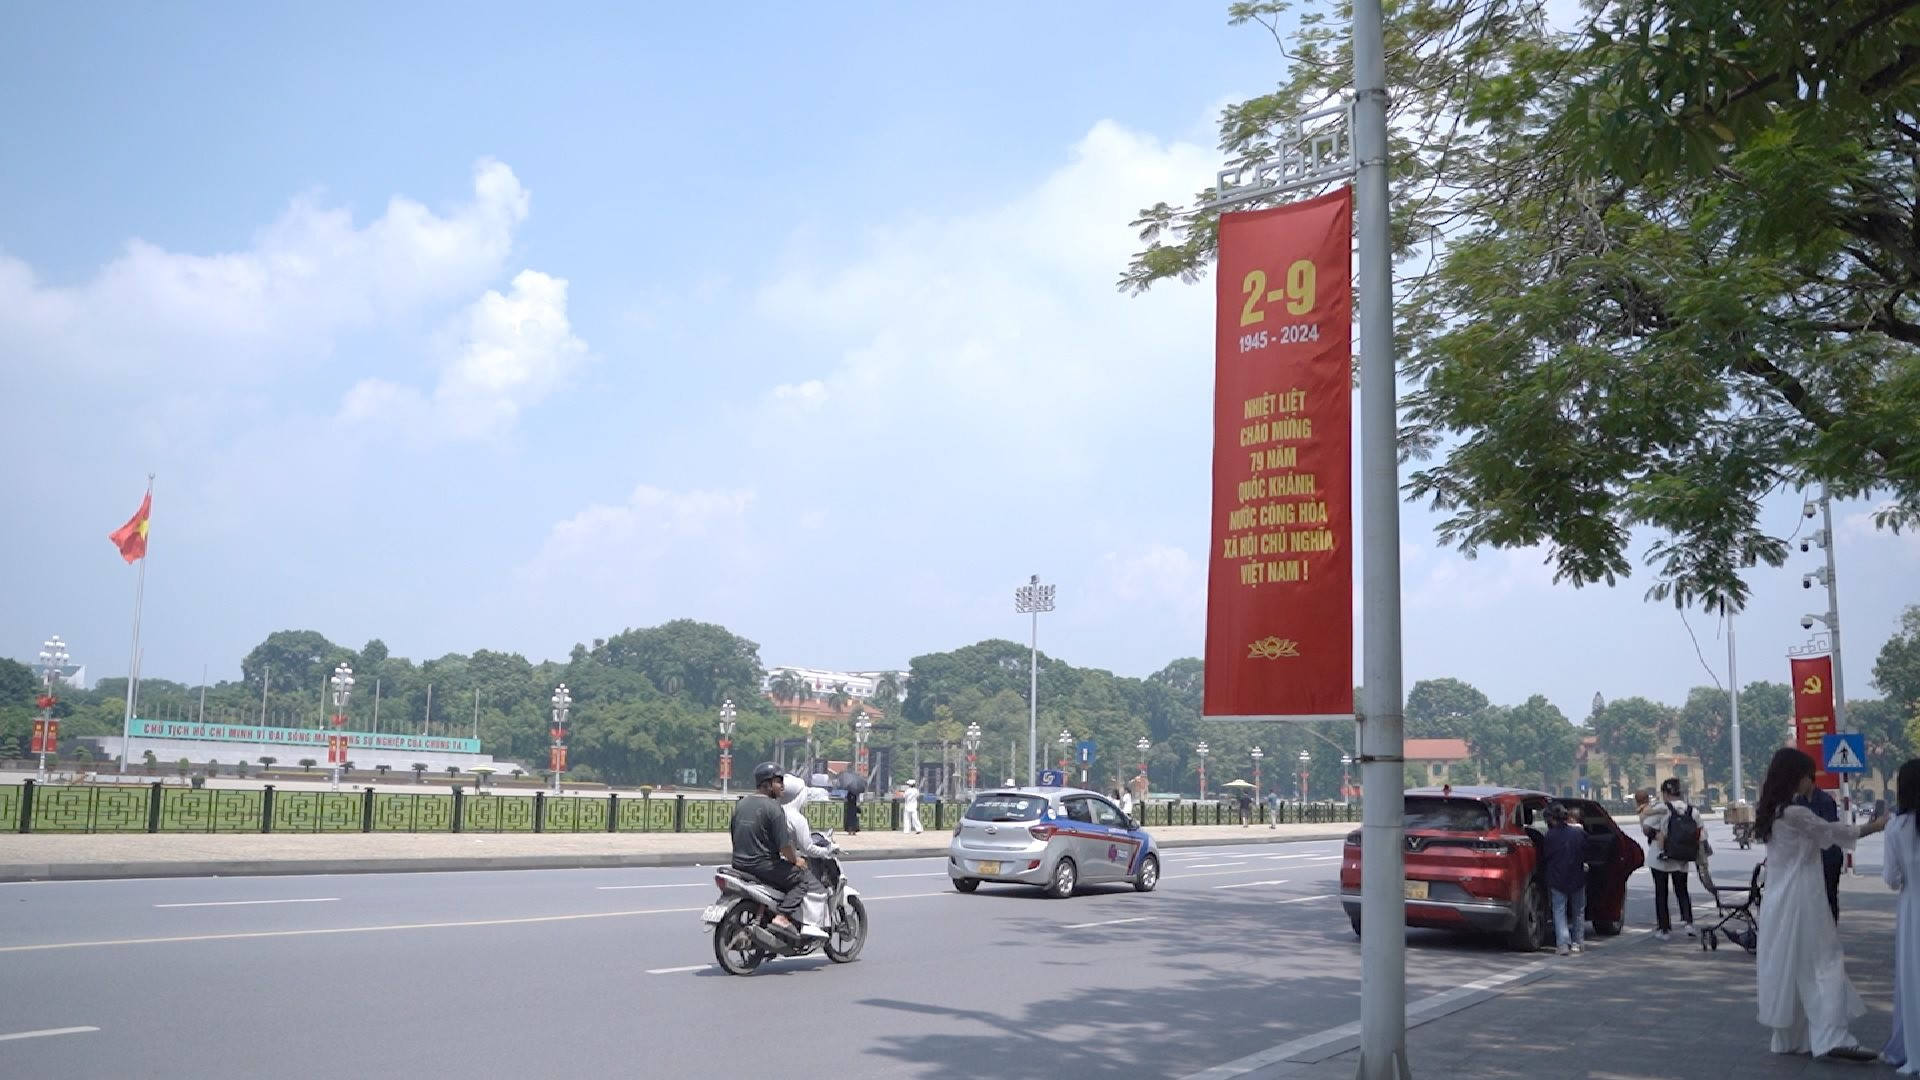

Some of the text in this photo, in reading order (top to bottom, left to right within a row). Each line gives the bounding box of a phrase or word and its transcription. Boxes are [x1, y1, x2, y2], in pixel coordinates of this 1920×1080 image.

[1240, 259, 1317, 327] 2-9
[1239, 331, 1268, 354] 1945
[1280, 324, 1320, 345] 2024
[1244, 387, 1306, 420] NHIỆT LIỆT
[1240, 415, 1312, 447] CHÀO MỪNG
[1250, 444, 1297, 473] 79 NĂM
[1238, 470, 1316, 504] QUỐC KHÁNH
[1229, 497, 1328, 531] NƯỚC CỘNG HÒA
[1223, 526, 1334, 561] XÃ HỘI CHỦ NGHĨA
[1240, 557, 1309, 589] VIỆT NAM !
[229, 728, 253, 739] MINH
